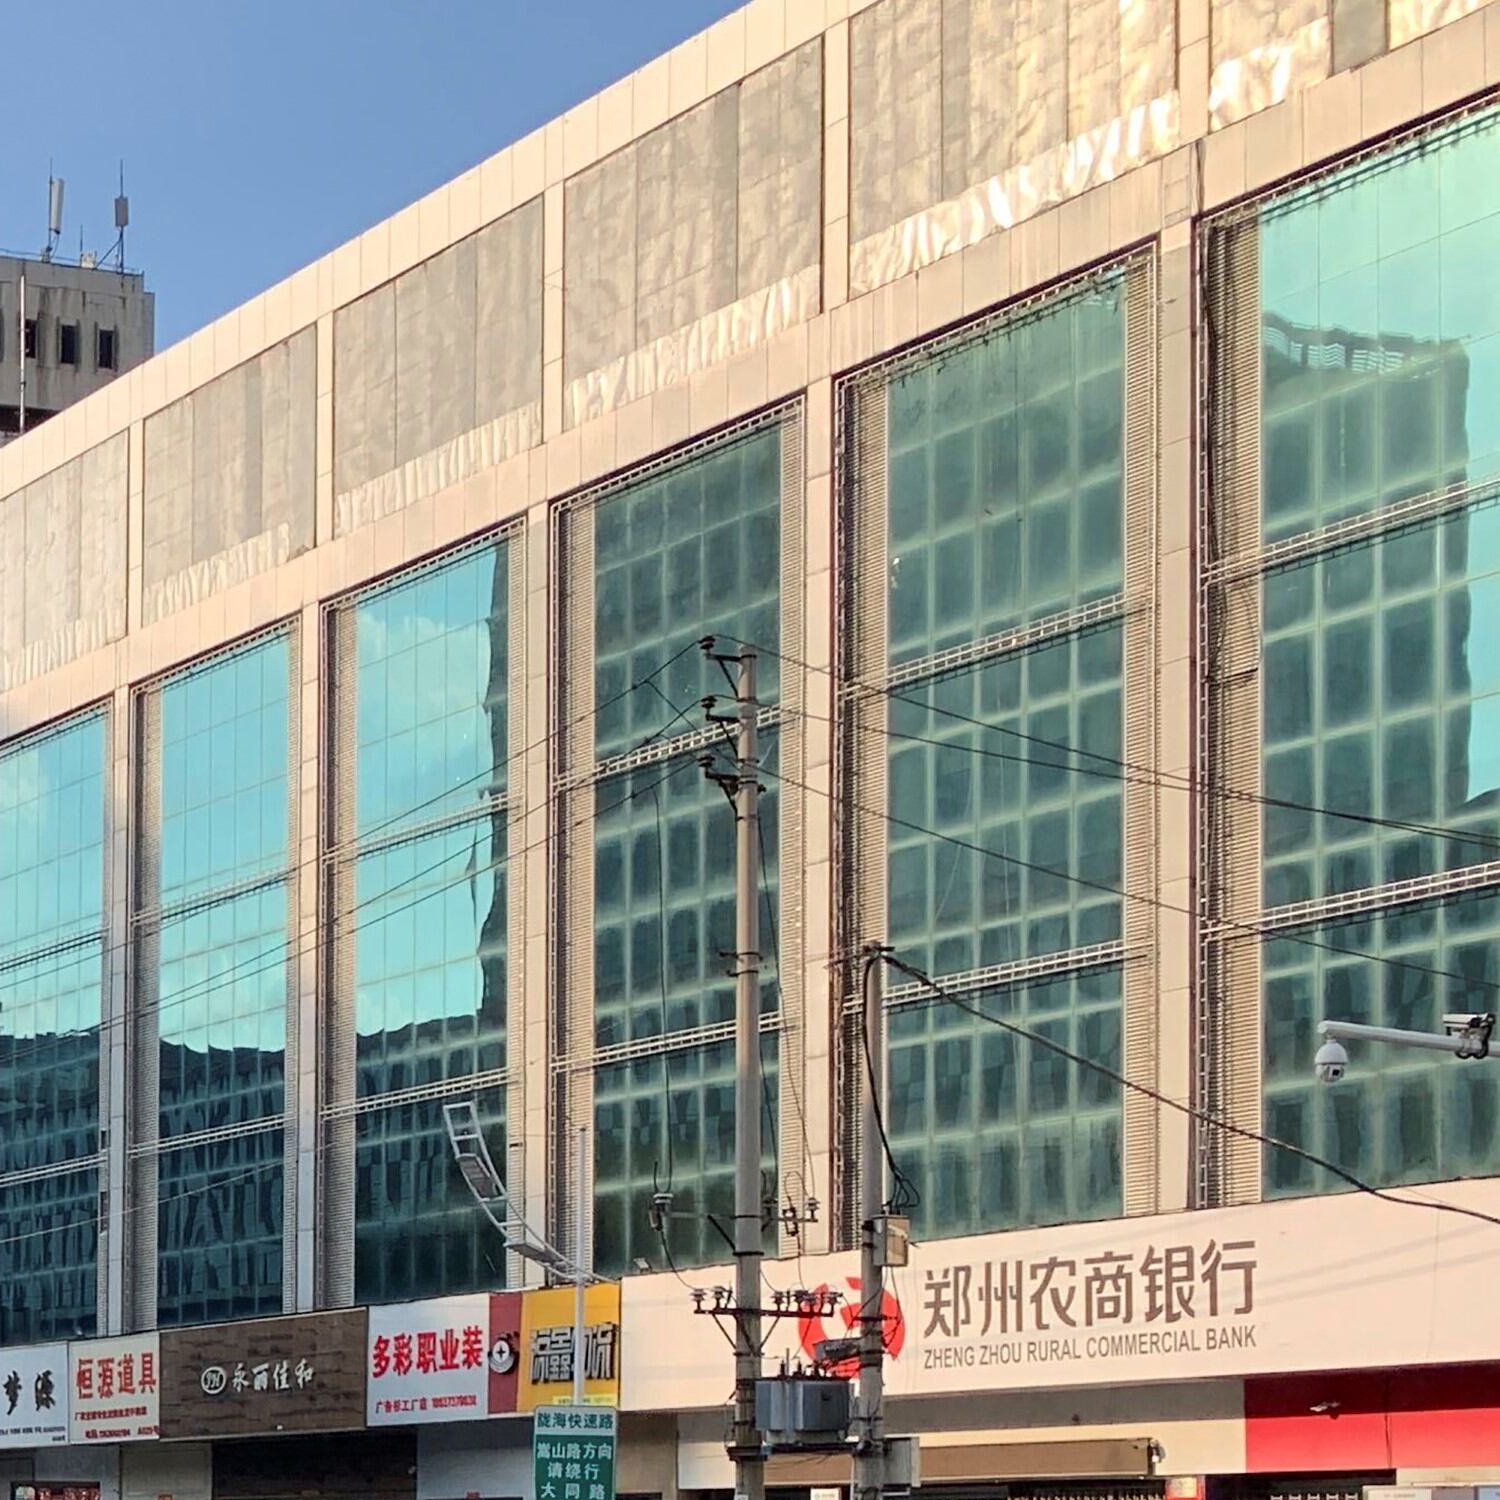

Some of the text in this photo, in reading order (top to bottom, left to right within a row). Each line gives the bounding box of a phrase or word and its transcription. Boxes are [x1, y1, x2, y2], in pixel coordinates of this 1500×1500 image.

[923, 1238, 1257, 1338] 郑州农商银行
[373, 1325, 484, 1379] 多彩职业装
[924, 1325, 1257, 1370] ZHENG ZHOU RURAL COMMERCIAL BANK
[76, 1353, 157, 1400] 恒源道具
[231, 1357, 315, 1393] 永丽佳和
[537, 1412, 613, 1429] 陇海快速路
[537, 1442, 612, 1460] 嵩山路方向
[547, 1462, 600, 1480] 请绕行
[541, 1481, 605, 1500] 大同路
